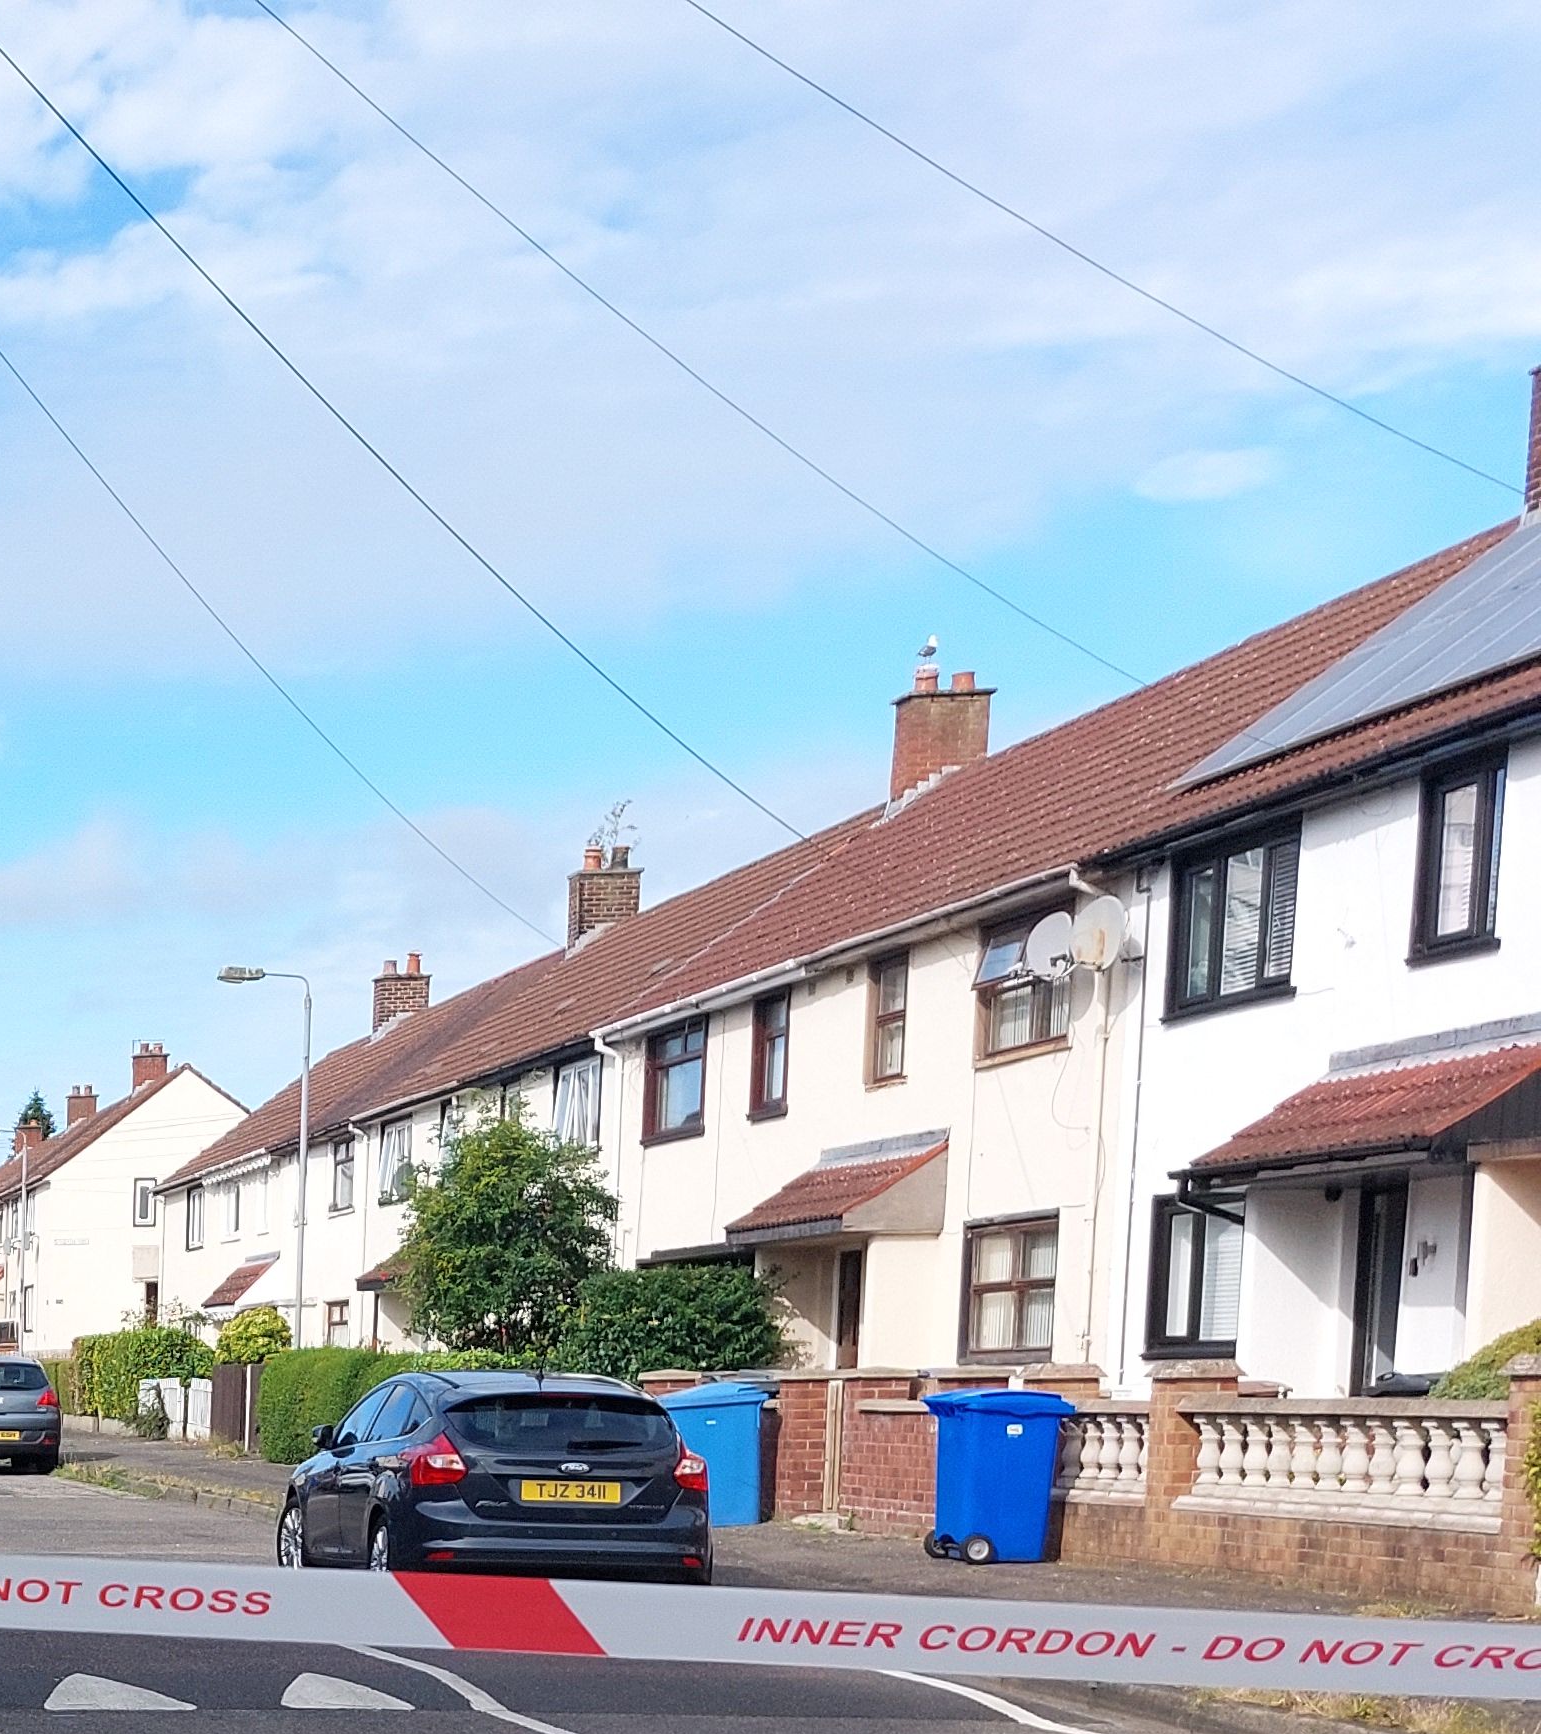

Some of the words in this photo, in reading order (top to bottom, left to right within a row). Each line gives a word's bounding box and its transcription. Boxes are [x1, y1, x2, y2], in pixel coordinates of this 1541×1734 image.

[536, 1483, 570, 1498] TJZ
[97, 1583, 271, 1617] CROSS
[737, 1616, 903, 1649] INNER
[918, 1624, 1157, 1659] CORDON
[1202, 1634, 1286, 1663] DO
[1300, 1639, 1419, 1666] NOT
[1434, 1645, 1541, 1672] CRO
